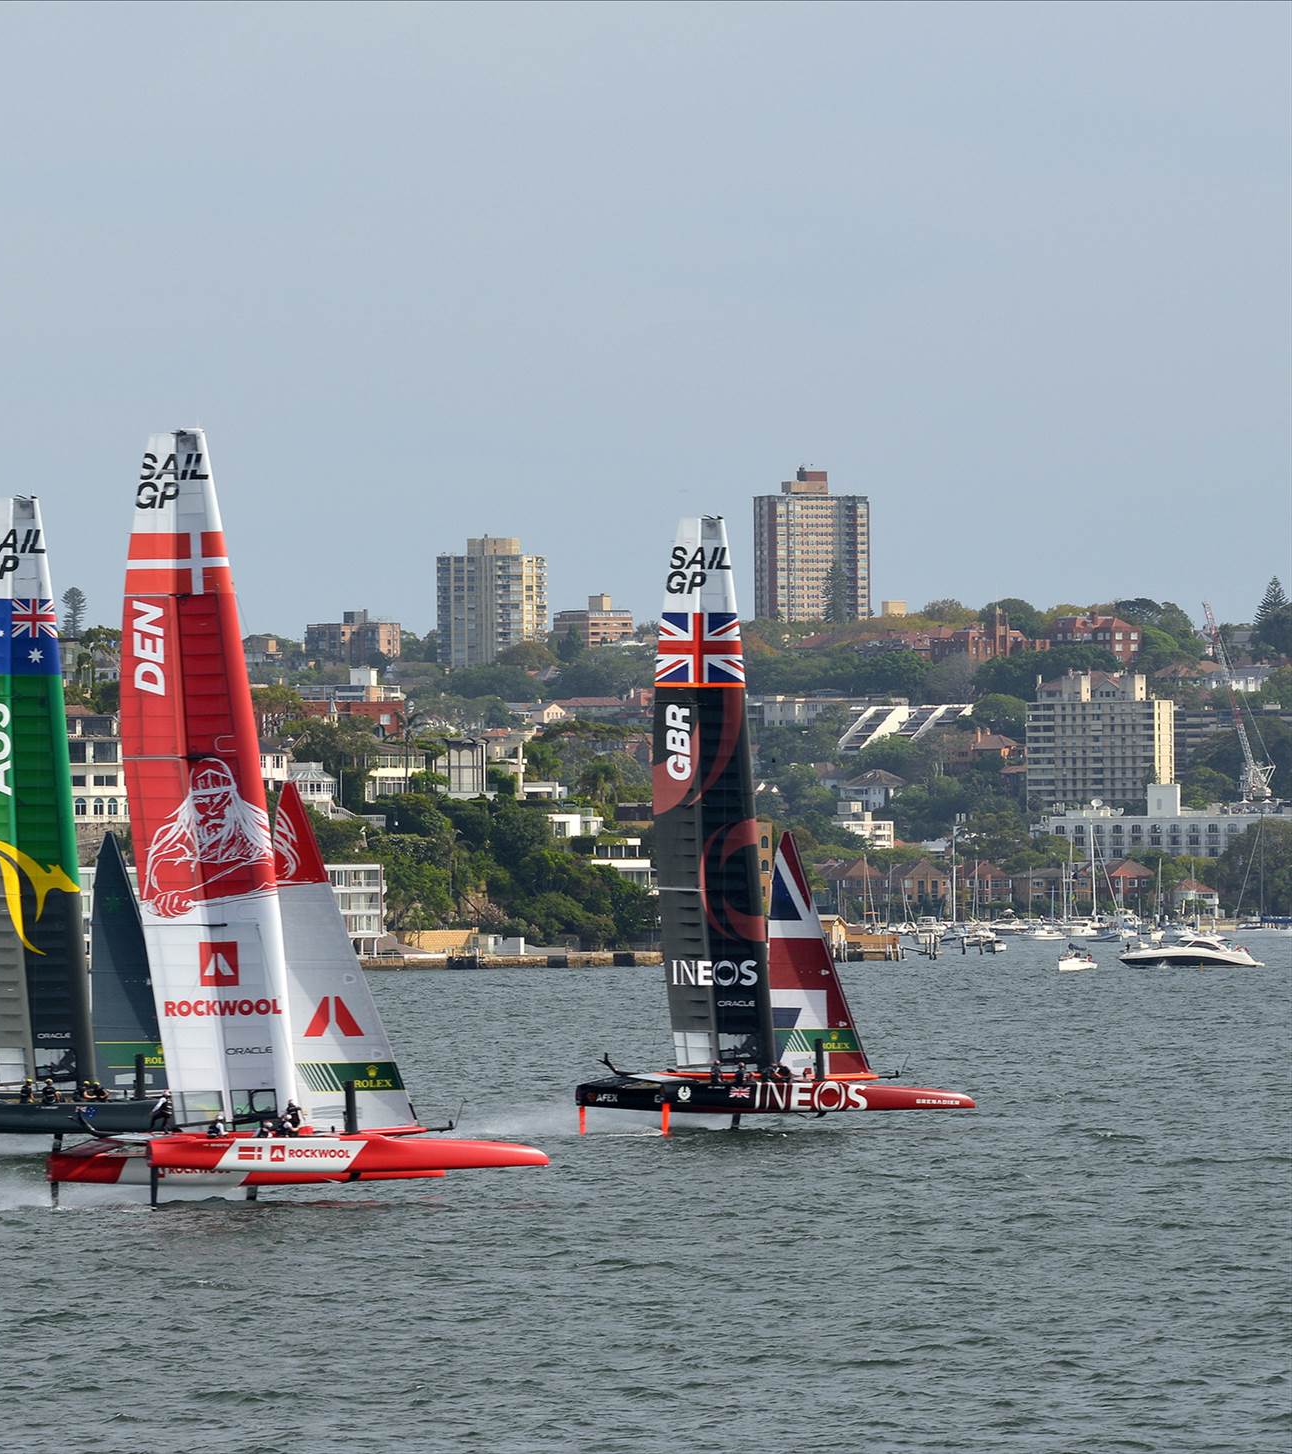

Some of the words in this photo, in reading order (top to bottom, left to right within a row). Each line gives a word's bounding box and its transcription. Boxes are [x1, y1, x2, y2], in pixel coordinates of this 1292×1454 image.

[140, 452, 209, 480] SAIL
[135, 481, 180, 509] GP
[669, 546, 732, 570] SAIL
[666, 570, 707, 595] GP
[132, 600, 166, 696] DEN
[665, 704, 691, 781] GBR
[672, 959, 758, 986] INEOS
[164, 999, 283, 1017] ROCKWOOL
[717, 1000, 756, 1008] ORACLE
[225, 1046, 273, 1056] ORACLE
[354, 1080, 392, 1088] ROLEX
[754, 1081, 867, 1110] INEOS
[288, 1149, 350, 1159] ROCKWOOL
